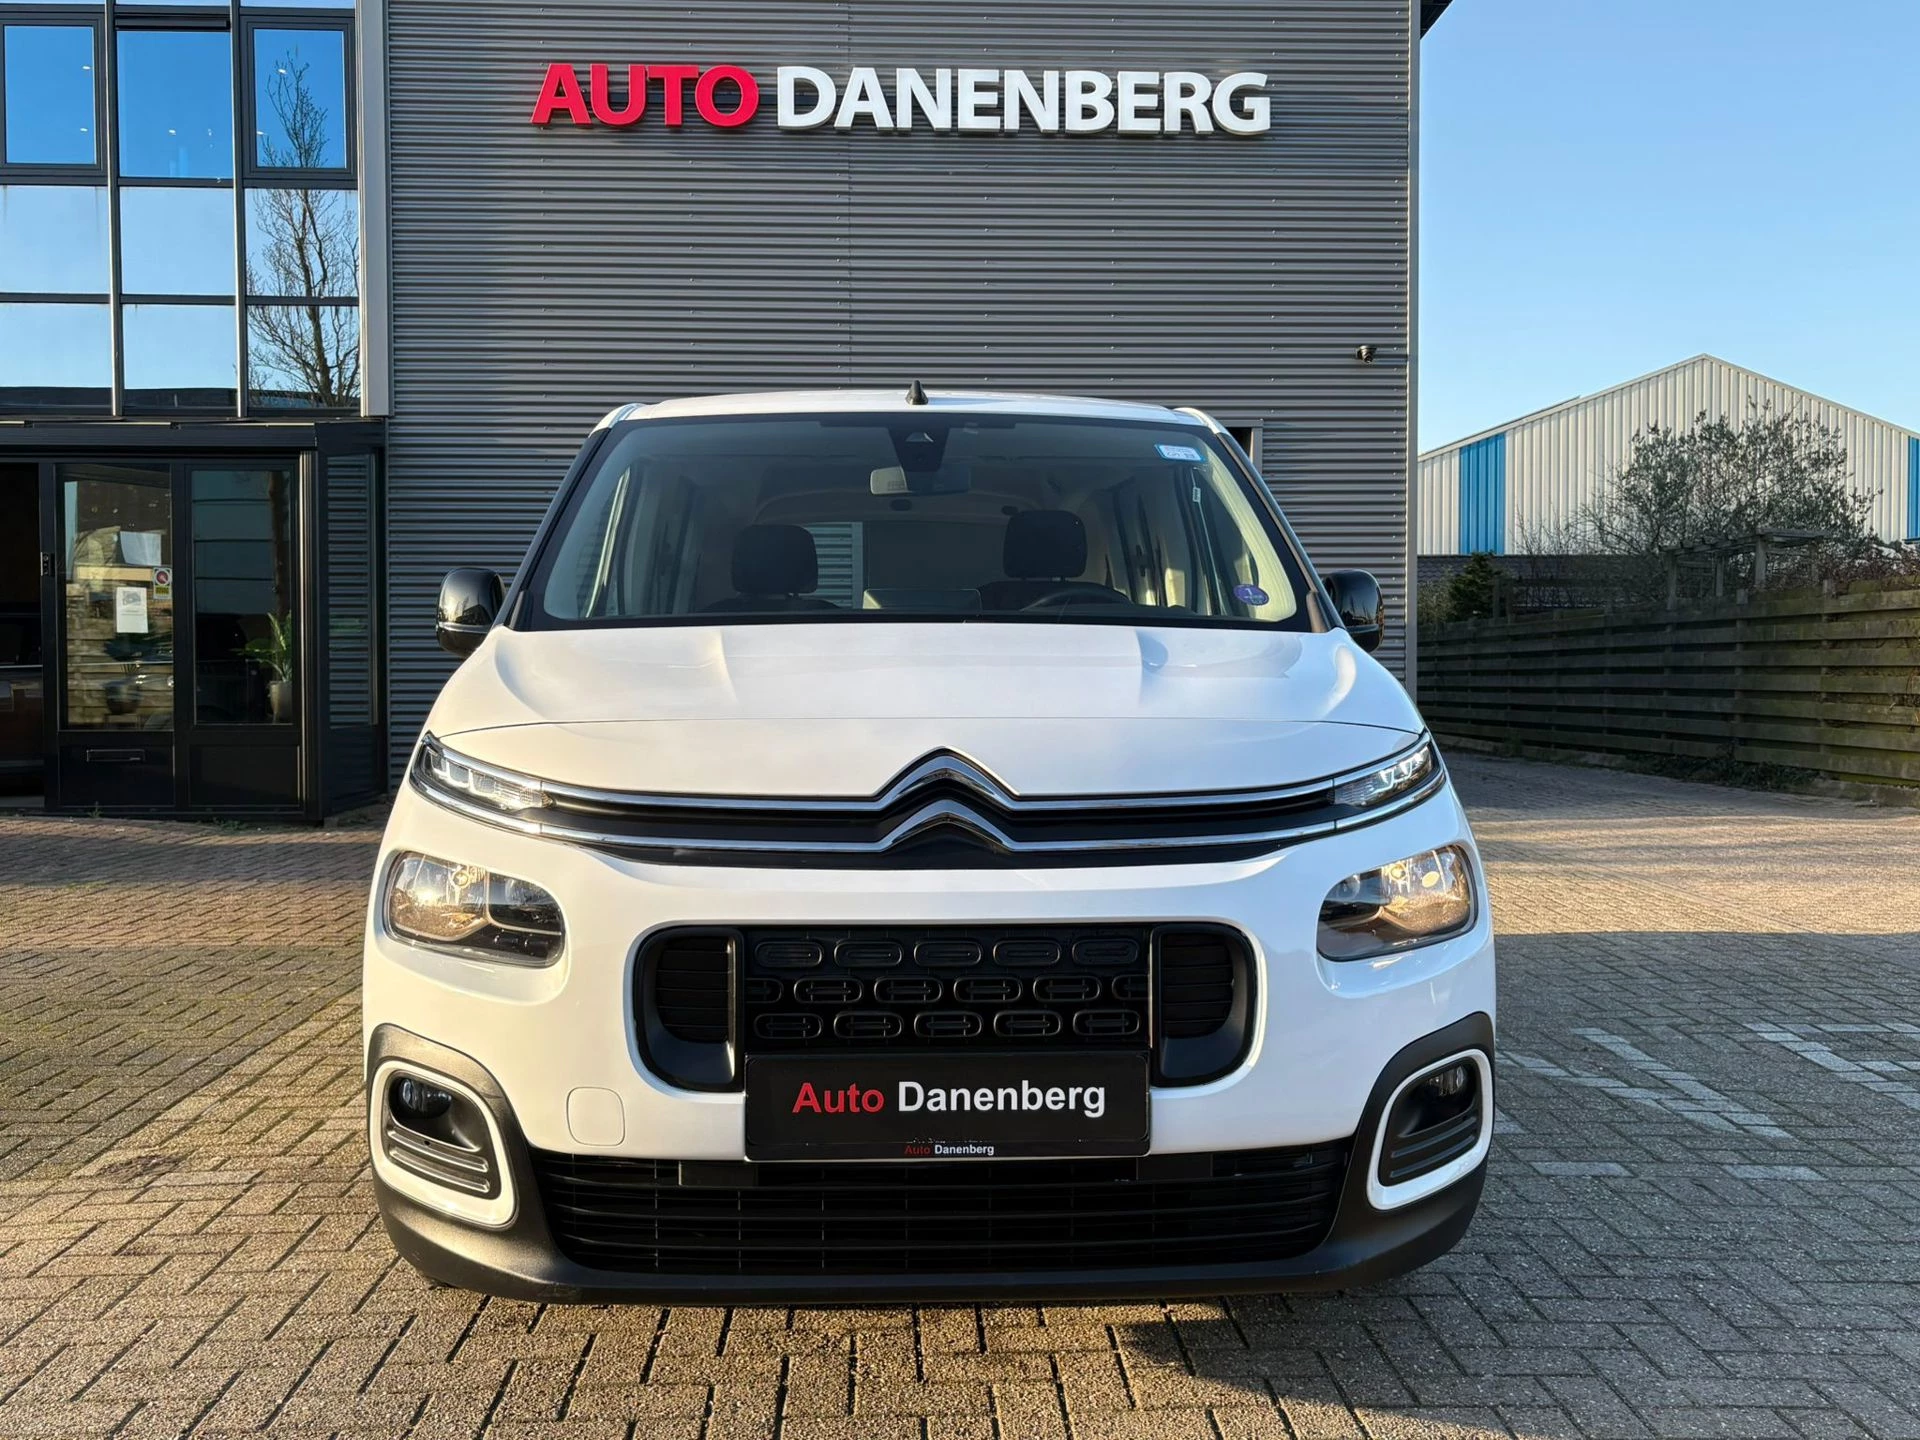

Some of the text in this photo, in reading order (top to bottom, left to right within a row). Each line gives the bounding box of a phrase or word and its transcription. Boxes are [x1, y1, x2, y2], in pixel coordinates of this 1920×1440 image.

[530, 64, 1271, 135] AUTO DANENBERG
[792, 1080, 1105, 1118] Auto Danenberg
[904, 1144, 994, 1156] Auto Danenberg
